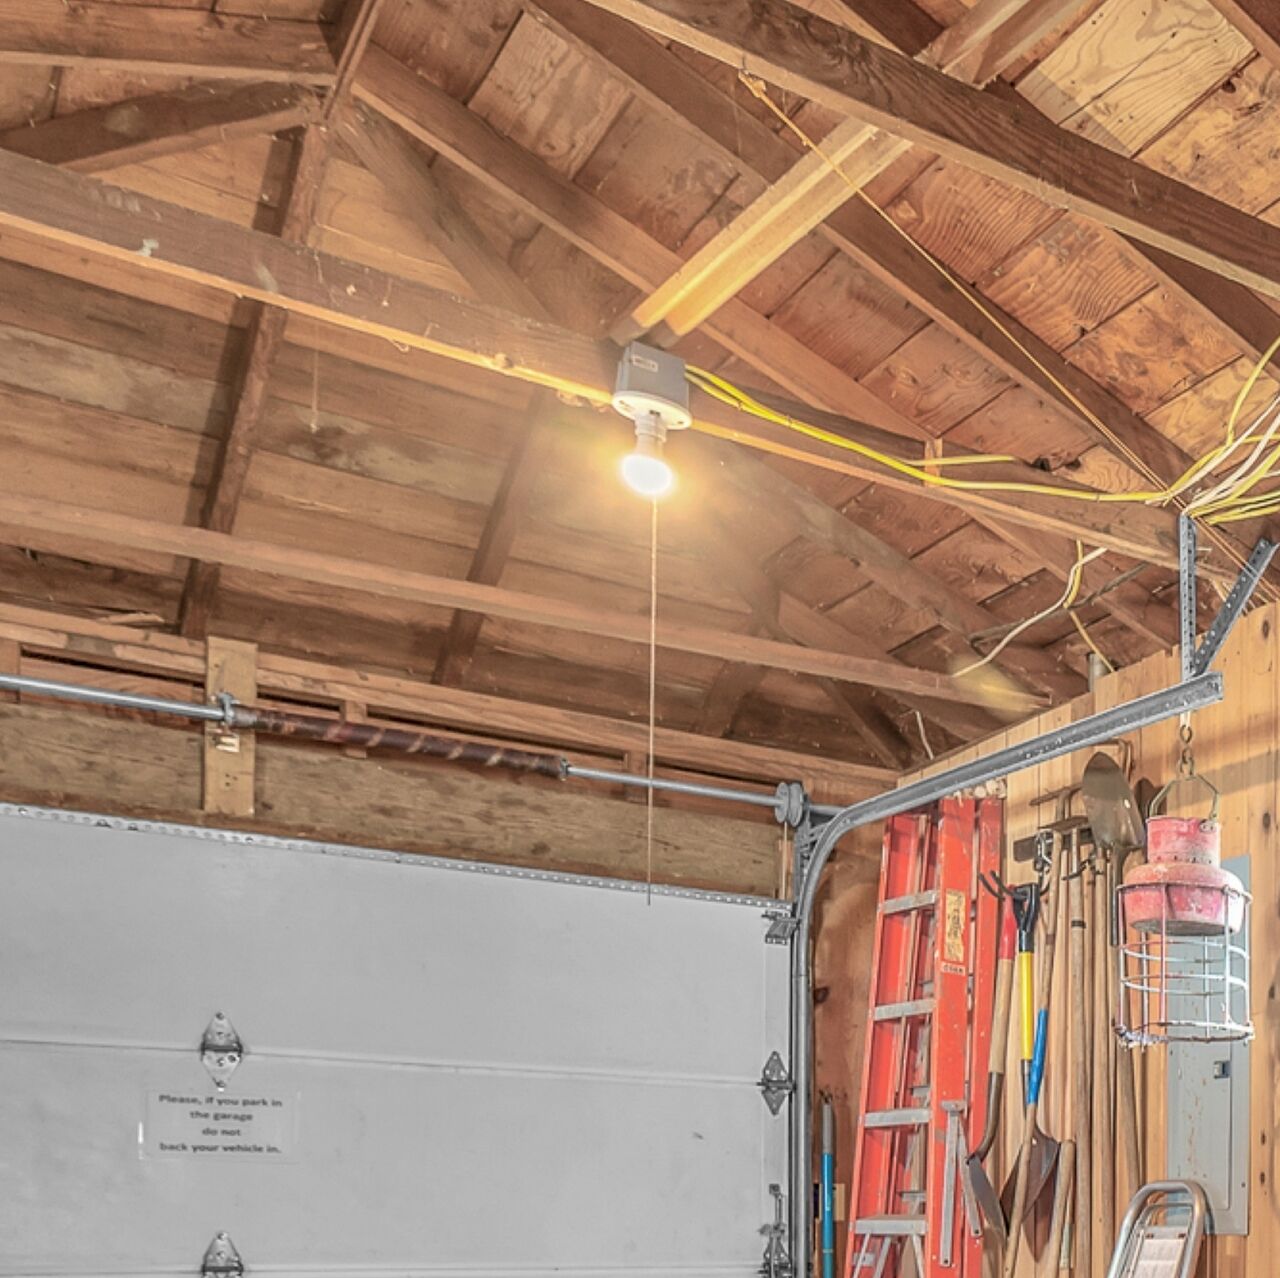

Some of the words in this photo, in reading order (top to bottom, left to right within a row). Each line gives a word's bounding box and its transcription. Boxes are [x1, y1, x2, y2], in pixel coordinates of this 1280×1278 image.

[158, 1094, 201, 1105] Please,
[242, 1098, 267, 1107] park
[271, 1099, 282, 1107] in
[189, 1111, 210, 1119] the
[213, 1112, 253, 1121] garage
[202, 1128, 218, 1136] do
[220, 1128, 241, 1136] not
[159, 1143, 187, 1151] back
[191, 1144, 219, 1153] your
